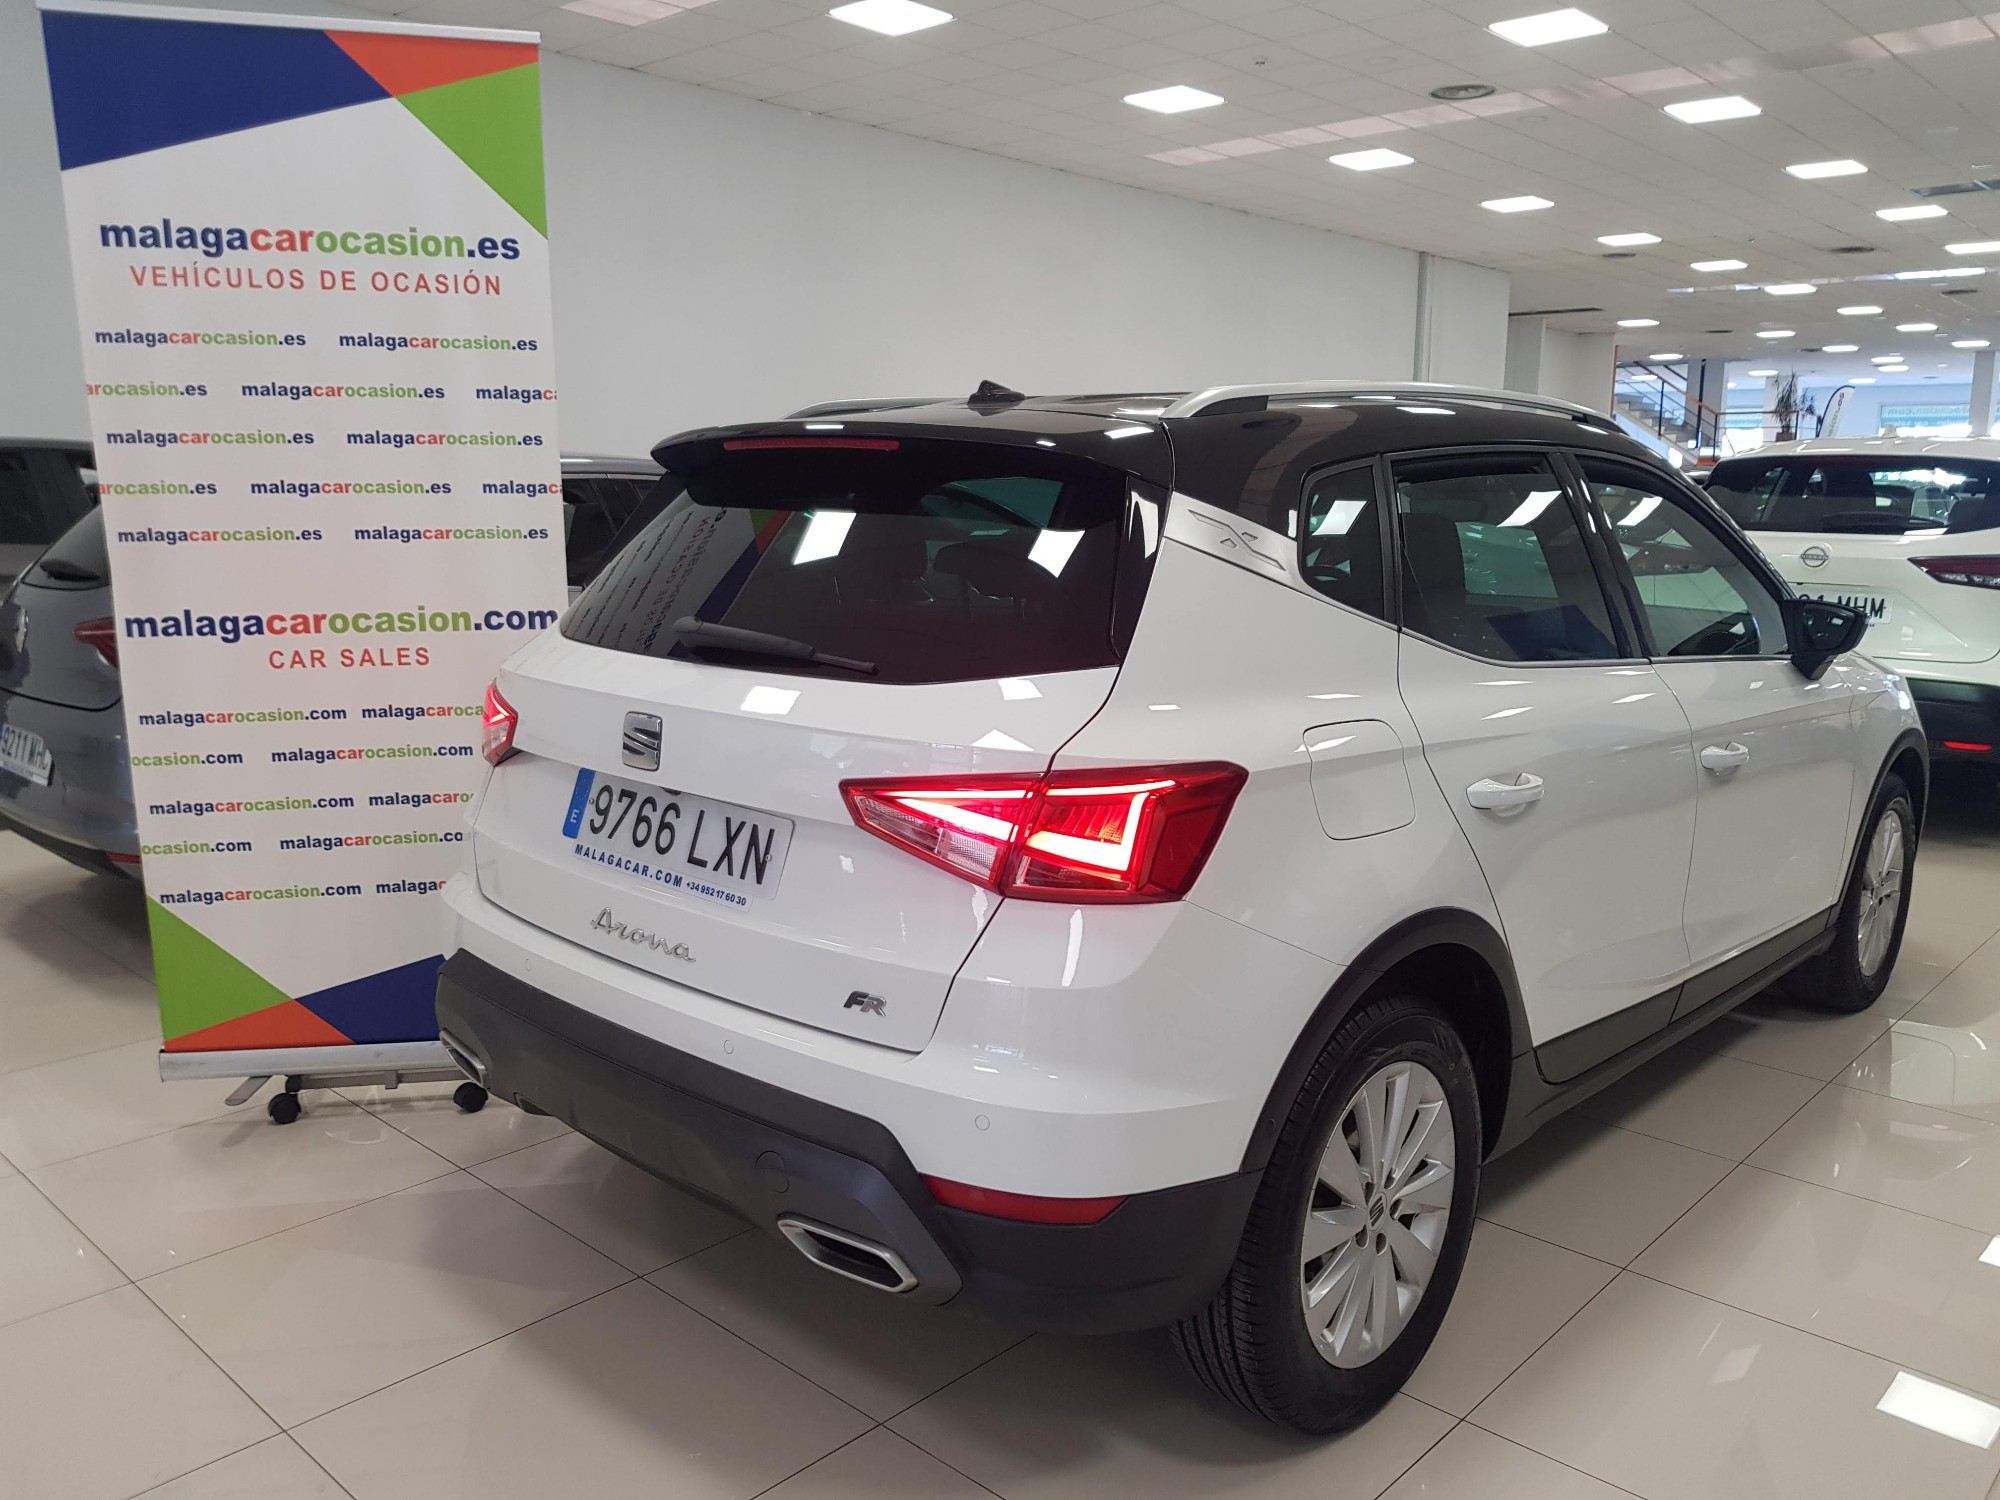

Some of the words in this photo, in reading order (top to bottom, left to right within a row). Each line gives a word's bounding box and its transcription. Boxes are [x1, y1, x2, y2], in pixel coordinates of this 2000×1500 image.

[100, 218, 521, 260] malagacarocasion.es
[130, 261, 304, 289] VEHÍCULOS
[320, 270, 356, 291] DE
[371, 269, 501, 296] OCASIÓN
[95, 329, 306, 348] malagacarocasion.es
[339, 332, 537, 351] malagacarocasion.es
[242, 382, 445, 400] malagacarocasion.es
[476, 385, 556, 403] malagac
[107, 429, 314, 447] malagacarocasion.es
[347, 430, 543, 448] malagacarocasion.es
[251, 480, 451, 497] malagacarocasion.es
[118, 527, 322, 545] malagacarocasion.es
[355, 526, 548, 543] malagacarocasion.es
[125, 607, 558, 643] malagacarocasion.com
[269, 649, 326, 669] CAR
[341, 647, 429, 667] SALES
[139, 708, 347, 727] malagacarocasion.com
[362, 704, 483, 720] malagacaroca
[132, 752, 243, 766] ocasion.com
[272, 744, 473, 764] malagacarocasion.com
[150, 797, 354, 816] malagacarocasion.com
[369, 792, 473, 807] malagacaro
[571, 808, 580, 823] E
[280, 831, 463, 851] malagacarocasion.co
[589, 784, 681, 855] 9766
[687, 809, 776, 885] LXN
[142, 841, 252, 855] ocasion.com
[575, 843, 684, 888] MALAGACAR.COM
[160, 885, 361, 904] malagacarocasion.com
[590, 907, 697, 962] Arona
[843, 991, 887, 1017] FR
